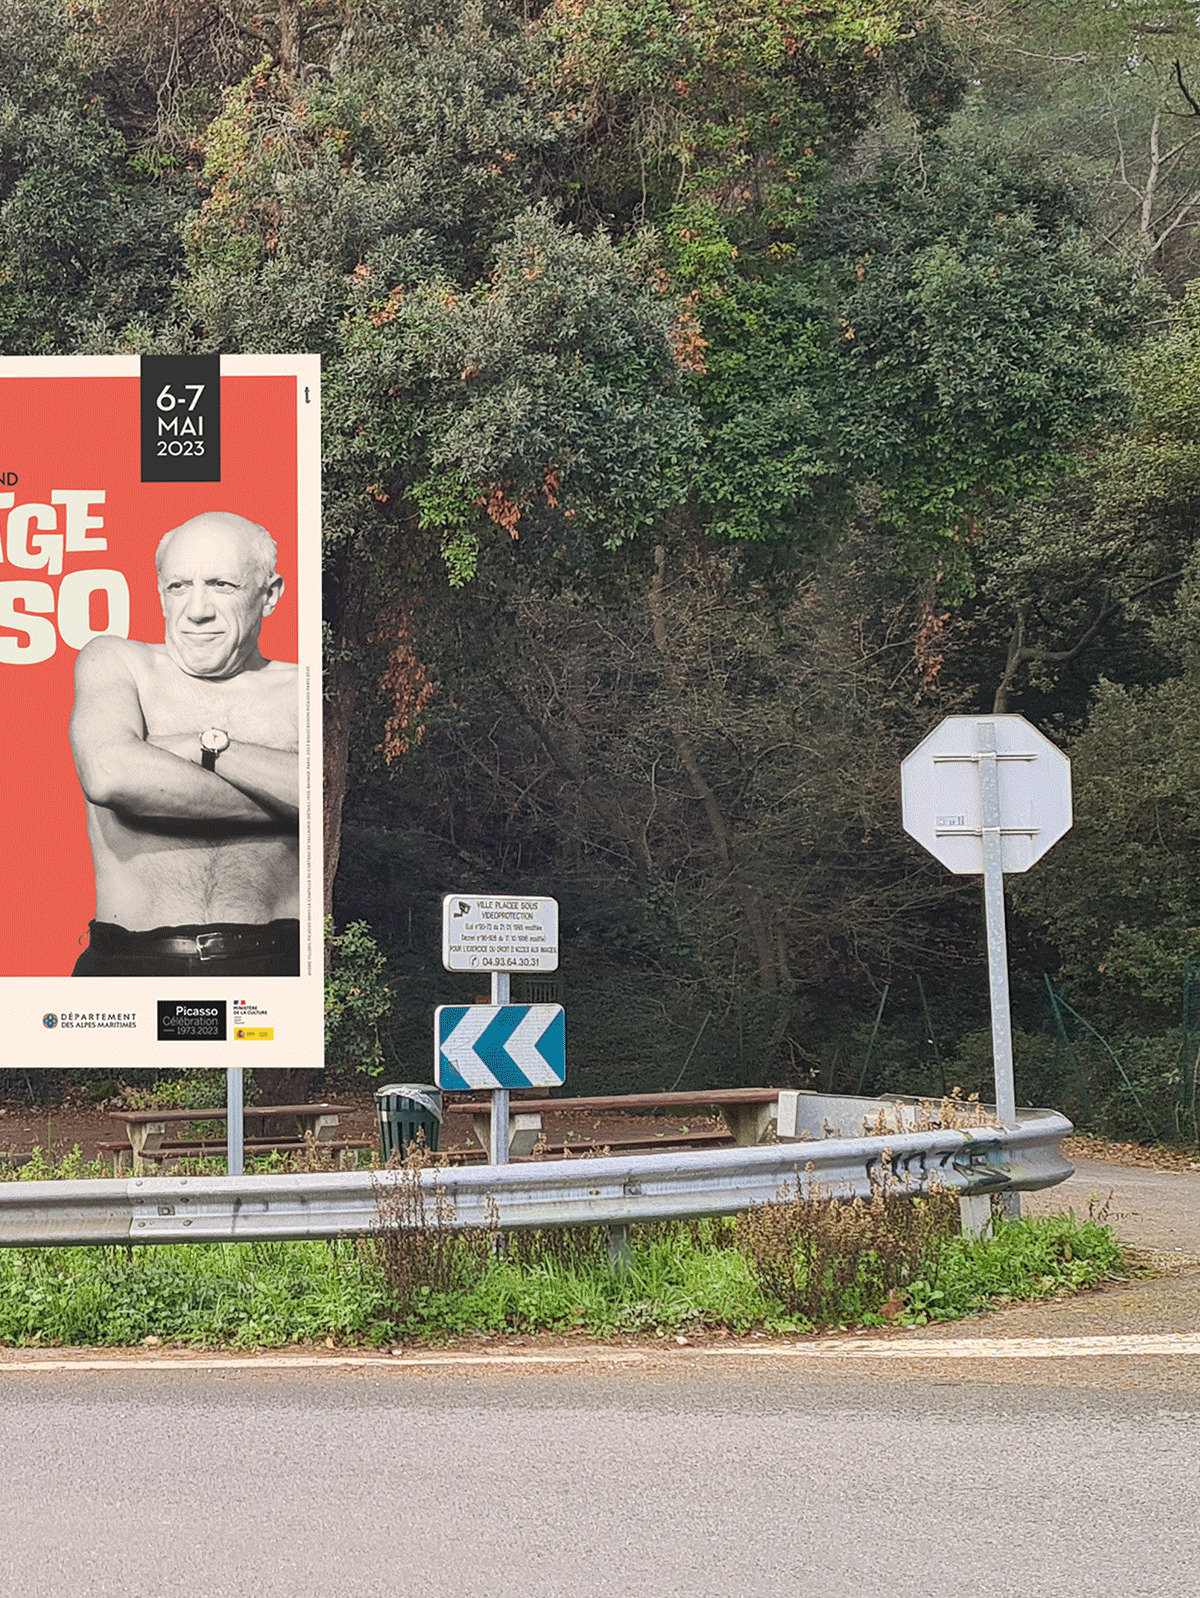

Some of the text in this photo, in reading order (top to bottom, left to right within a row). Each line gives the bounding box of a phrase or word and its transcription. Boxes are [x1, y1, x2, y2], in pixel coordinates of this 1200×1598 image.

[156, 384, 205, 411] 6-7
[158, 415, 203, 436] MAI
[157, 440, 205, 456] 2023
[476, 901, 493, 909] VILLE
[520, 902, 538, 910] SOUS
[482, 957, 540, 967] 04.93.64.30.31
[61, 1012, 137, 1021] DÉPARTEMENT
[176, 1005, 219, 1017] Picasso
[61, 1021, 74, 1029] DES
[162, 1015, 219, 1027] Célébration
